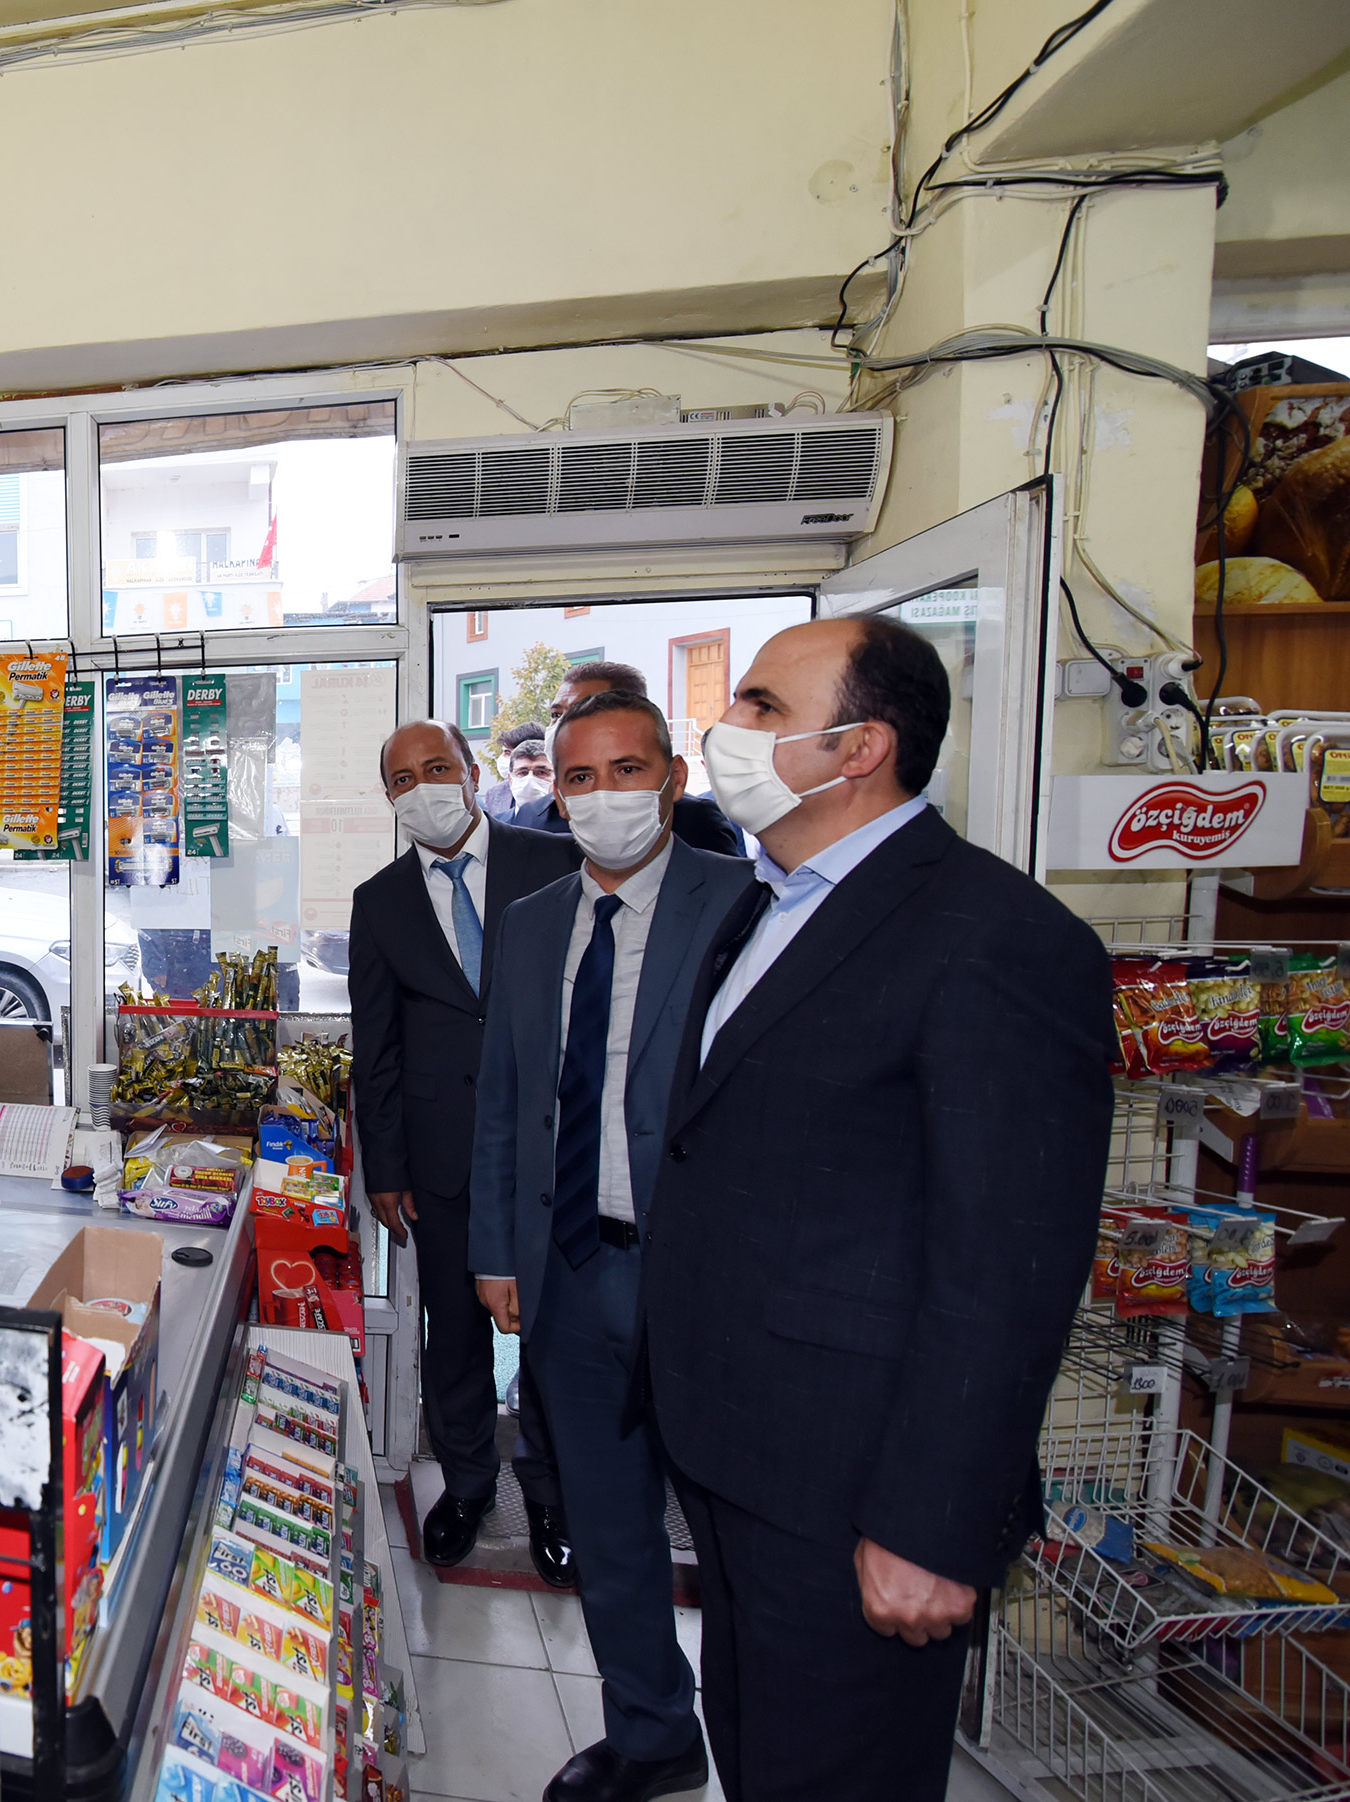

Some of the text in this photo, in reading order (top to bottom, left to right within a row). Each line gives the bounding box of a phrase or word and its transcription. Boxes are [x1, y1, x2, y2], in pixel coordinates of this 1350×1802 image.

[7, 661, 52, 672] Gillette
[9, 672, 48, 681] Permatik
[187, 688, 223, 701] DERBY
[63, 695, 91, 706] ERBY
[2, 814, 40, 824] Gillette
[3, 824, 37, 833] Permatik
[1172, 829, 1231, 845] kuruyemiş
